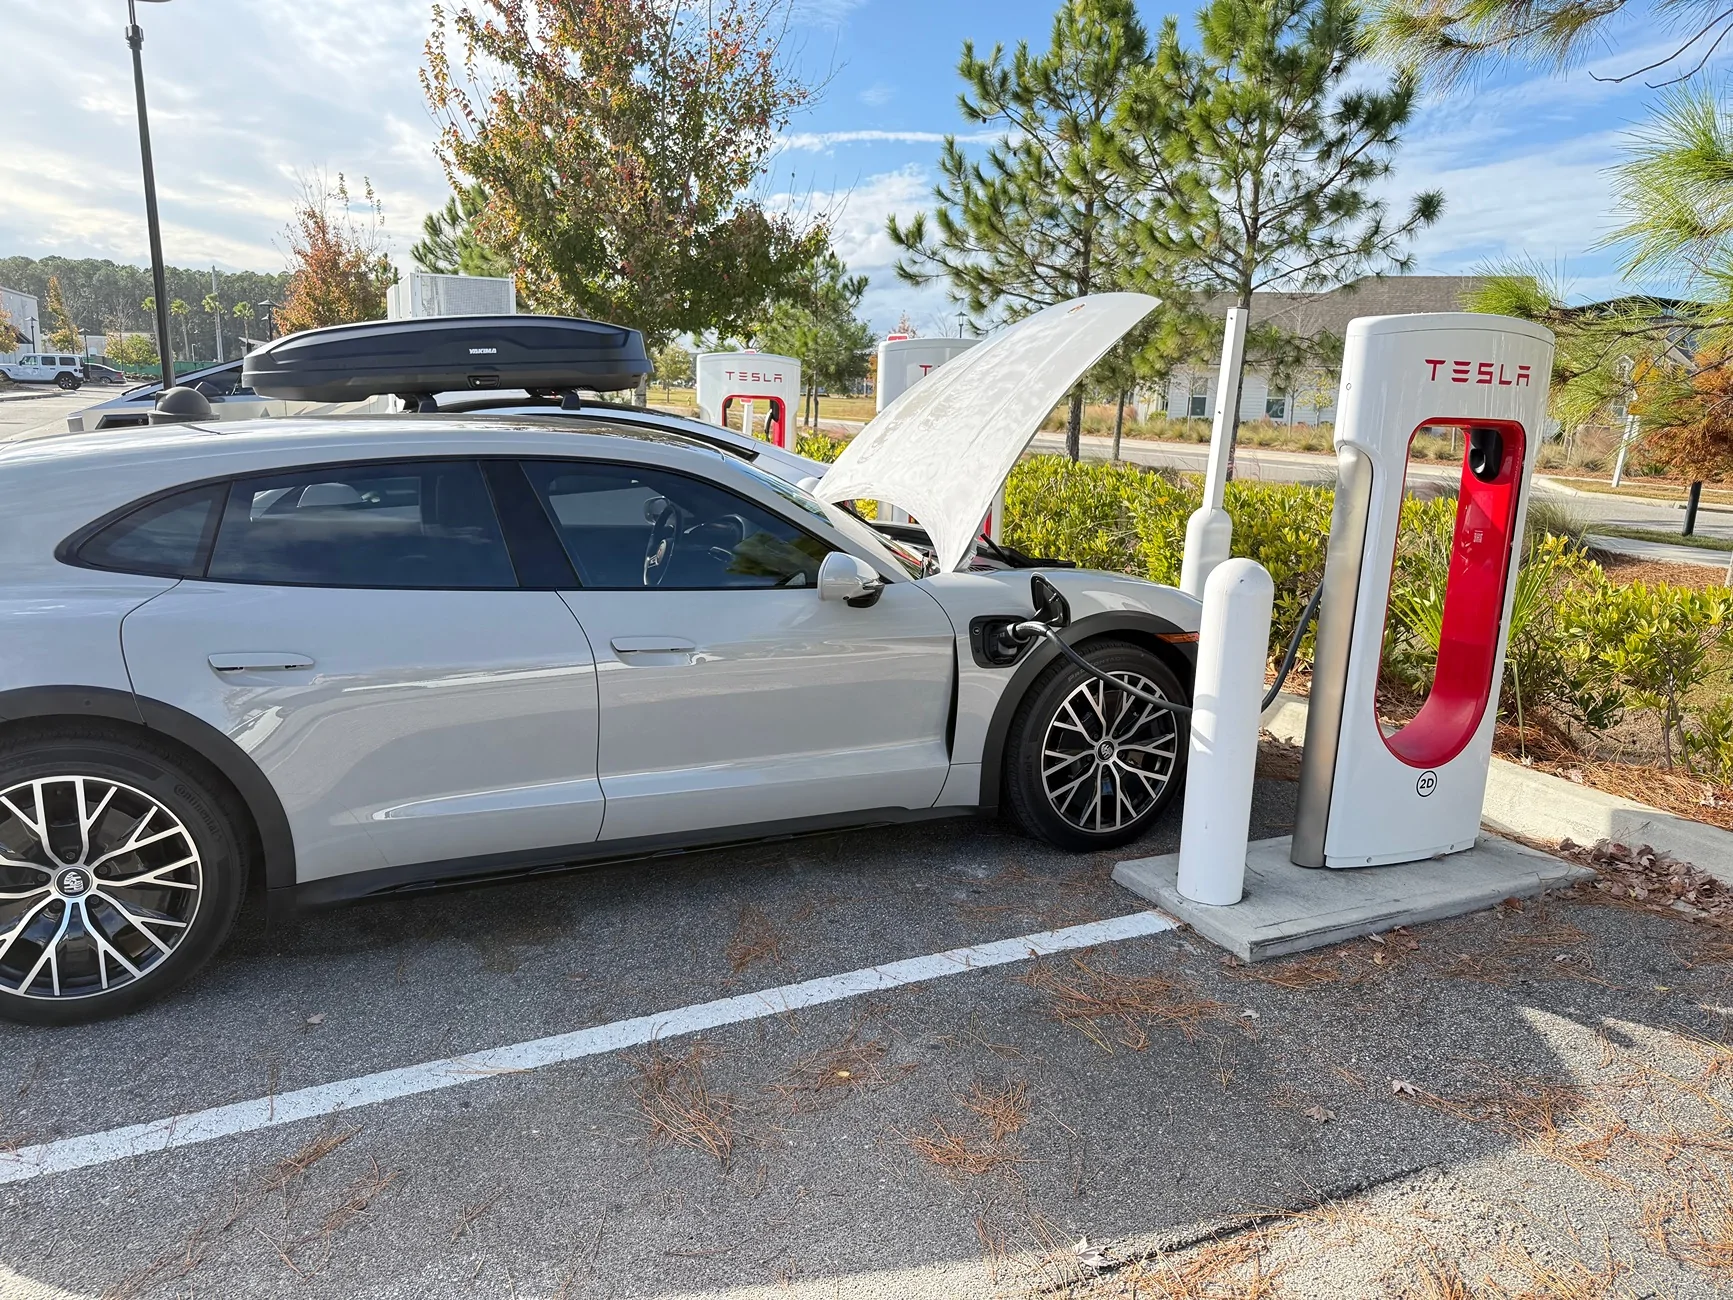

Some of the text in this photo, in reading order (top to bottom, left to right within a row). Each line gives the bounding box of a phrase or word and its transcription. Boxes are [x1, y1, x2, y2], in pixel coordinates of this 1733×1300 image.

[725, 371, 783, 383] TESLA
[1424, 359, 1531, 387] TESLA
[1419, 778, 1435, 789] 2D
